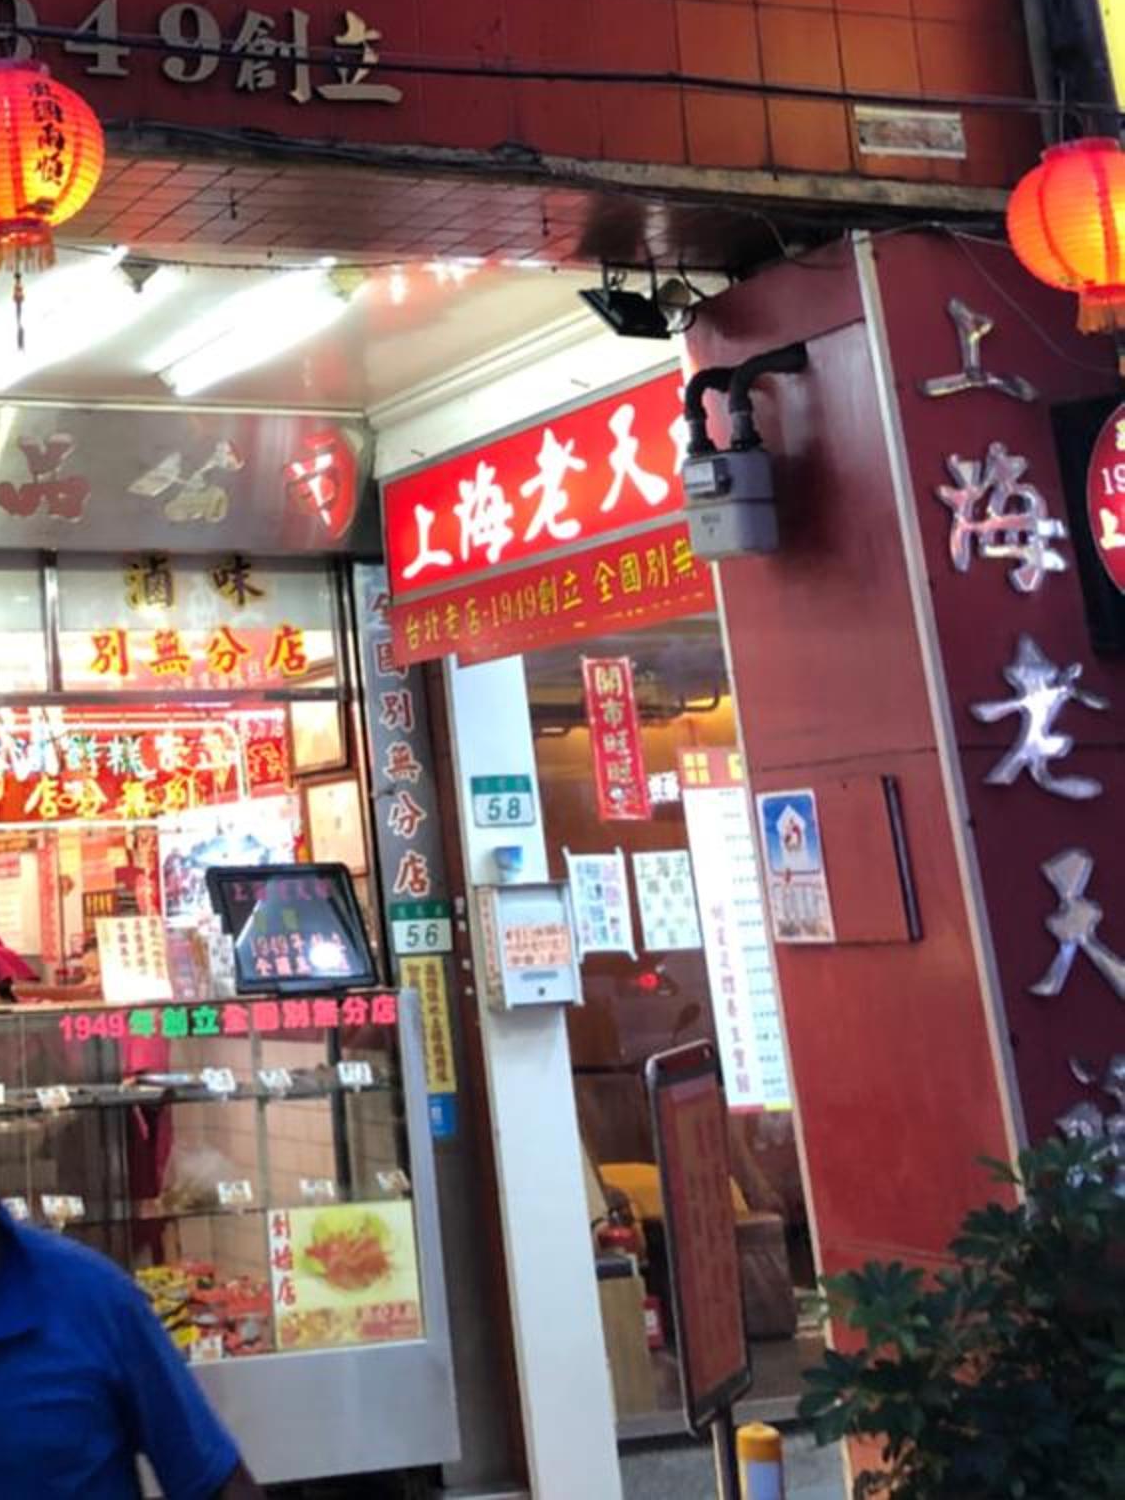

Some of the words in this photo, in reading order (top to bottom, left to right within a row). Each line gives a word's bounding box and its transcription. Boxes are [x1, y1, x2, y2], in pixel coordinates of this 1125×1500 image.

[89, 622, 311, 680] 別無分店
[488, 796, 522, 822] 58
[406, 924, 439, 948] 56
